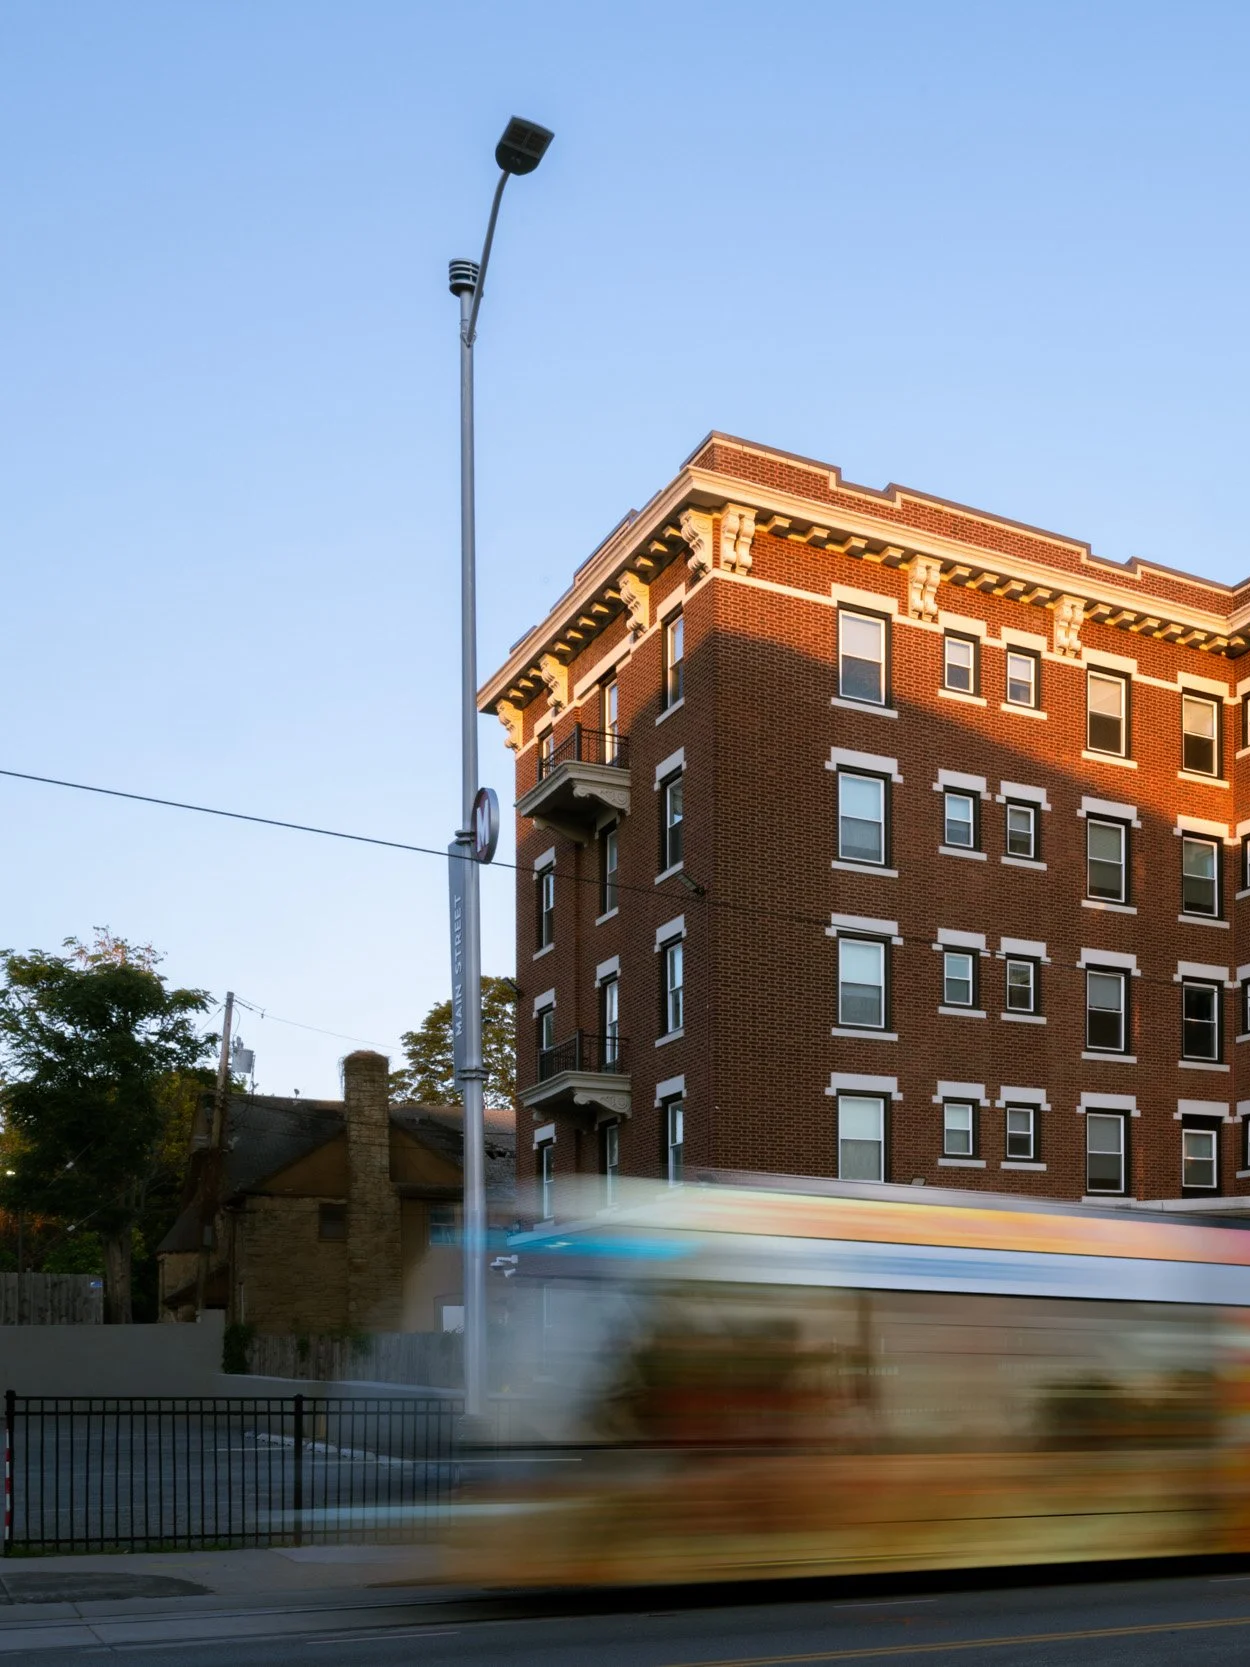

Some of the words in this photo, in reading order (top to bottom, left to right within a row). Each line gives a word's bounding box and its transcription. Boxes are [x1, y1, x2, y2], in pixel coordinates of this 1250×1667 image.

[477, 798, 489, 853] M
[454, 895, 462, 975] STREET
[455, 984, 463, 1036] MAIN
